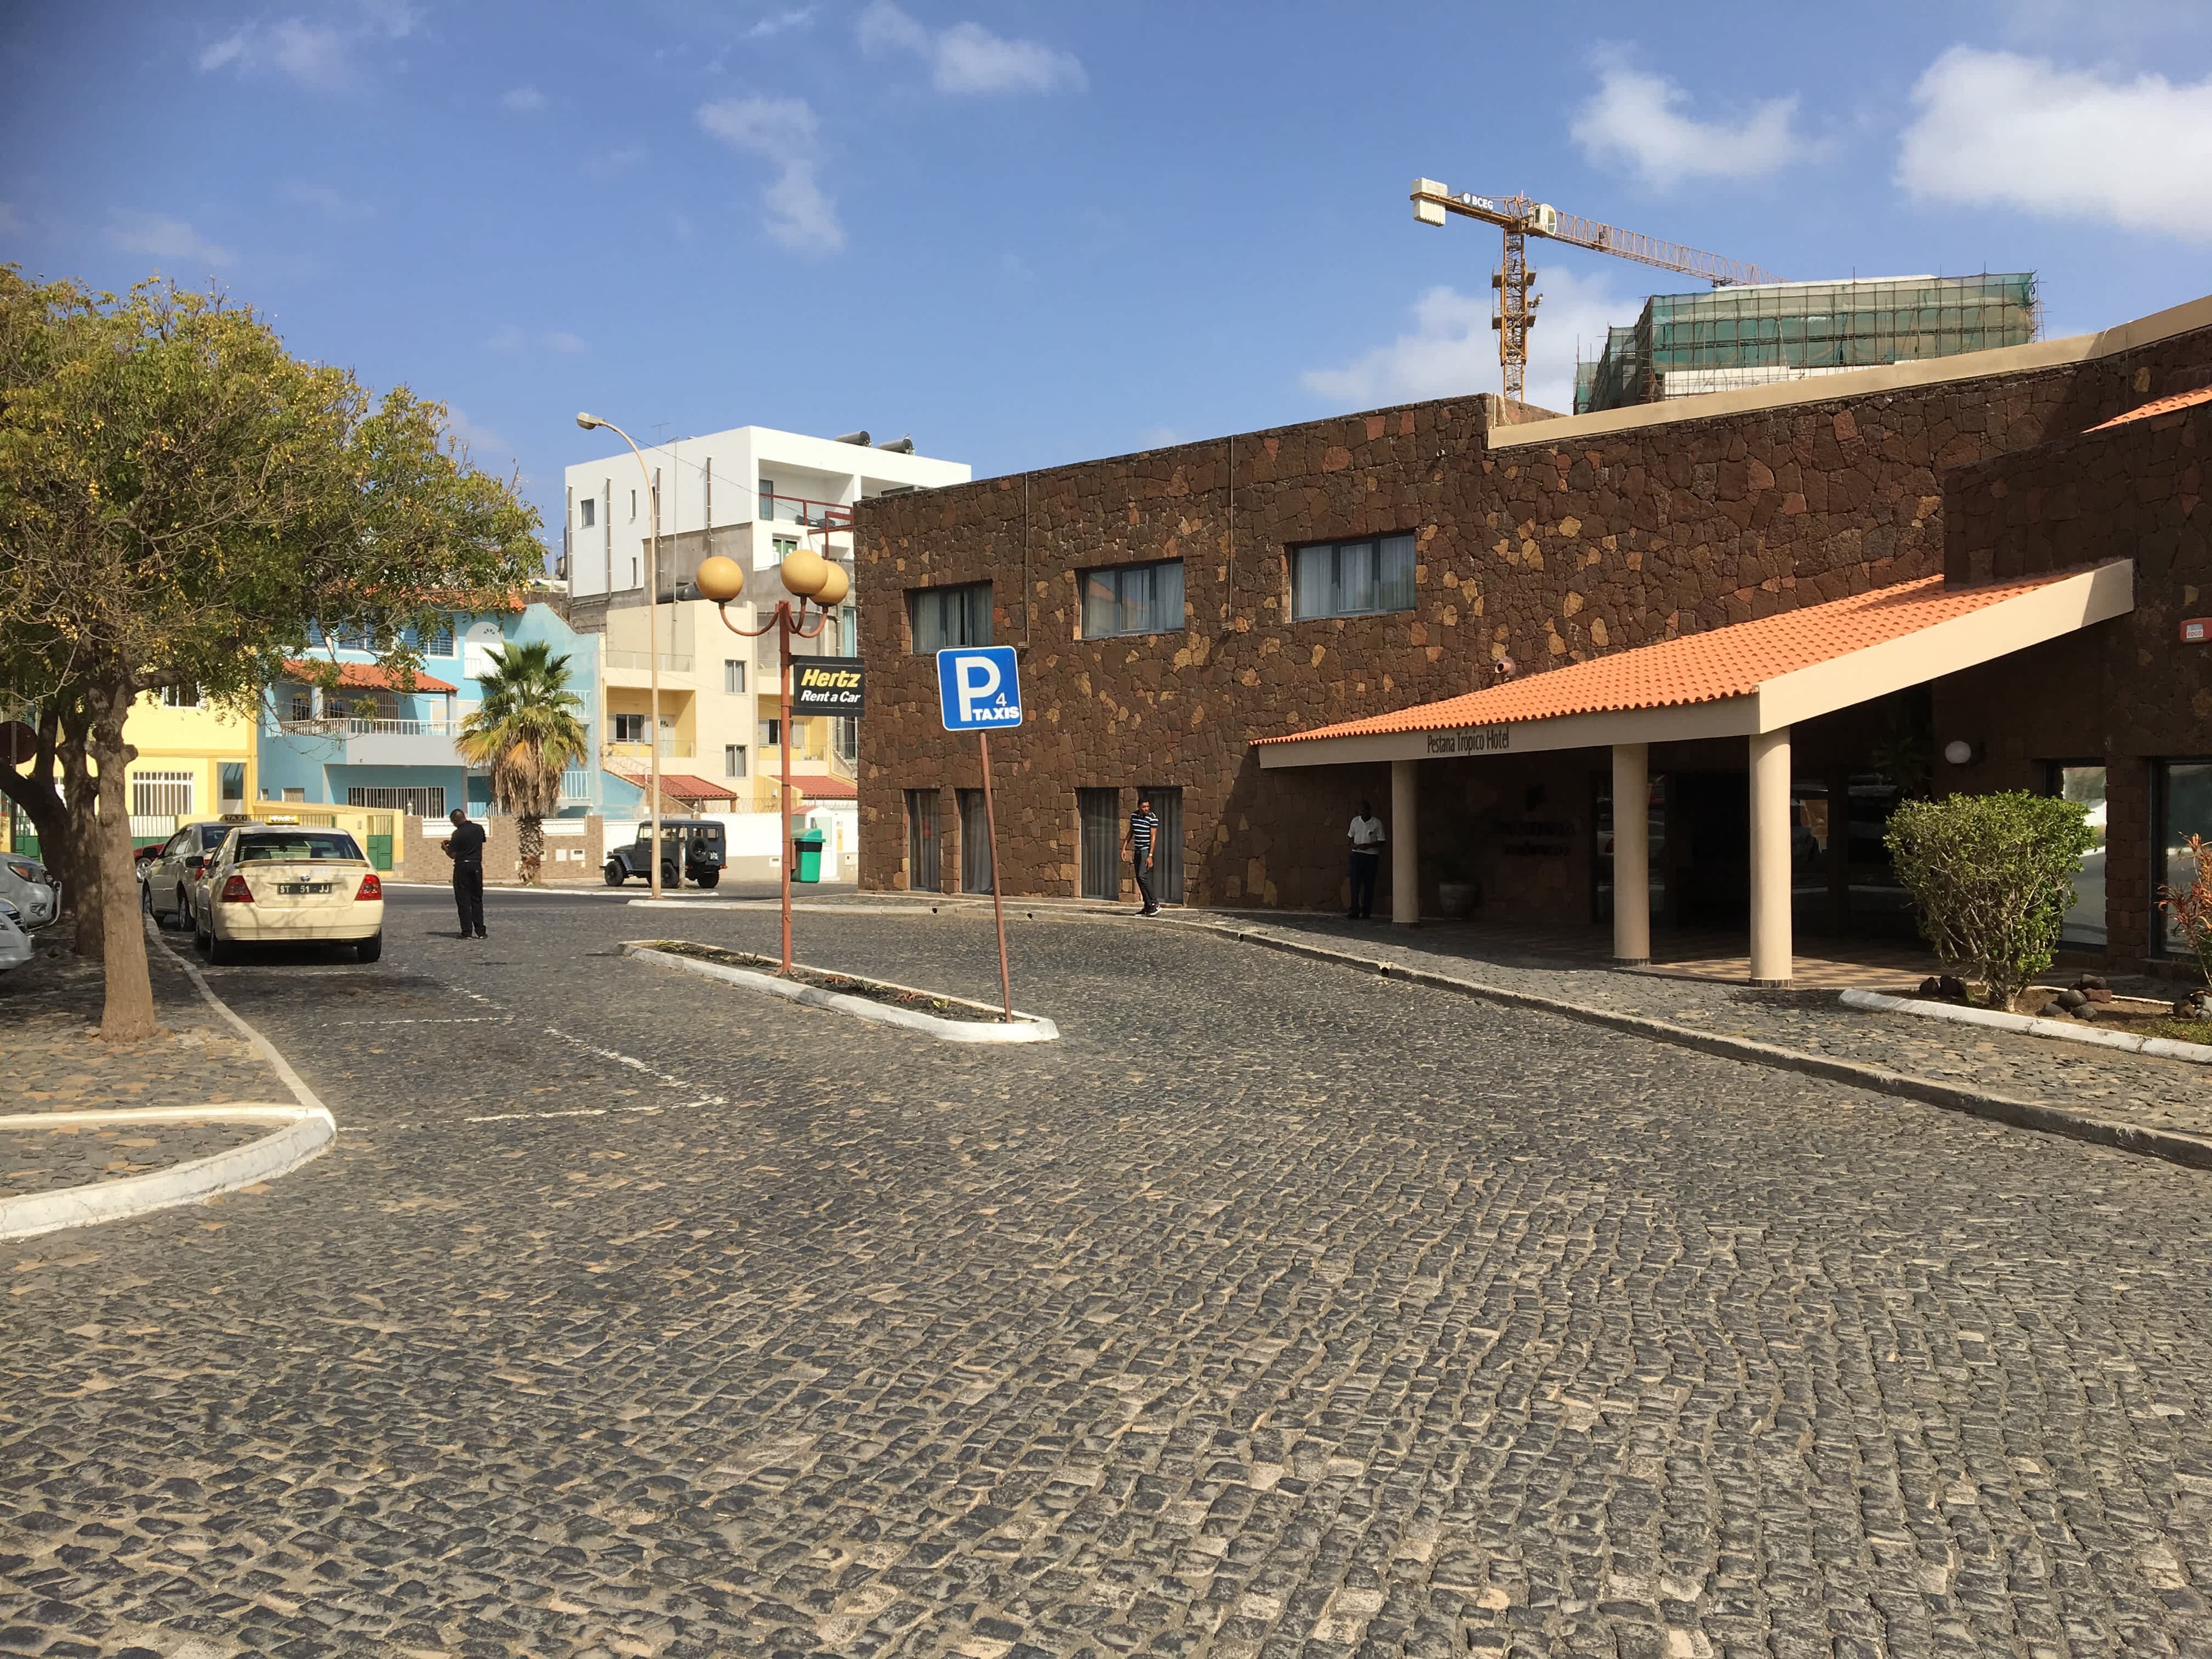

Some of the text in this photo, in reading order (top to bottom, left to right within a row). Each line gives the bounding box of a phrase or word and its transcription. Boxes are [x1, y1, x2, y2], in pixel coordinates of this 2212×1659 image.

[1472, 196, 1493, 210] BCEG
[801, 669, 861, 687] Hertz
[801, 690, 861, 702] Rent a Car
[955, 657, 1001, 722] P
[995, 692, 1007, 707] 4
[972, 706, 1020, 721] TAXIS
[1427, 726, 1509, 755] Pestana Trópico Hotel
